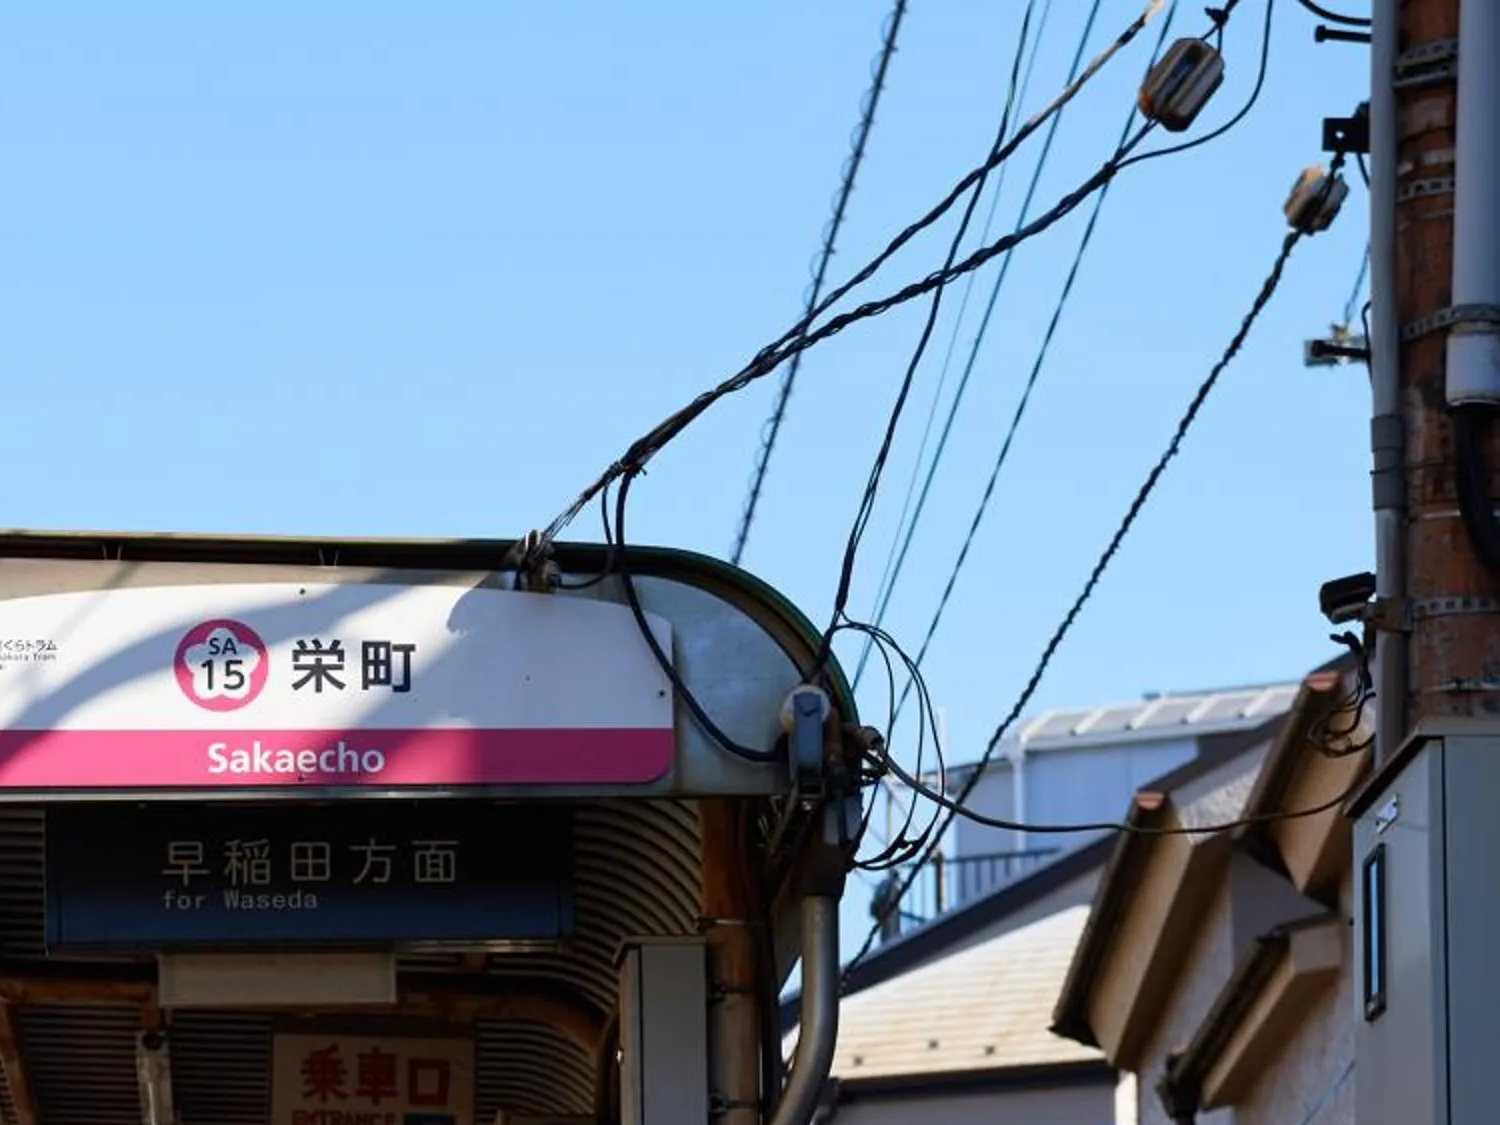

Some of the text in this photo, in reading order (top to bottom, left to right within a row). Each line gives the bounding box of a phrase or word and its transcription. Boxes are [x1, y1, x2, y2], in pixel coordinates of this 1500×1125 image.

[209, 637, 237, 656] SA
[200, 659, 246, 691] 15
[291, 638, 416, 693] 栄町
[207, 741, 386, 774] Sakaecho
[161, 838, 460, 887] 早稲田方面
[162, 889, 319, 910] for Waseda
[300, 1042, 452, 1108] 乗車口
